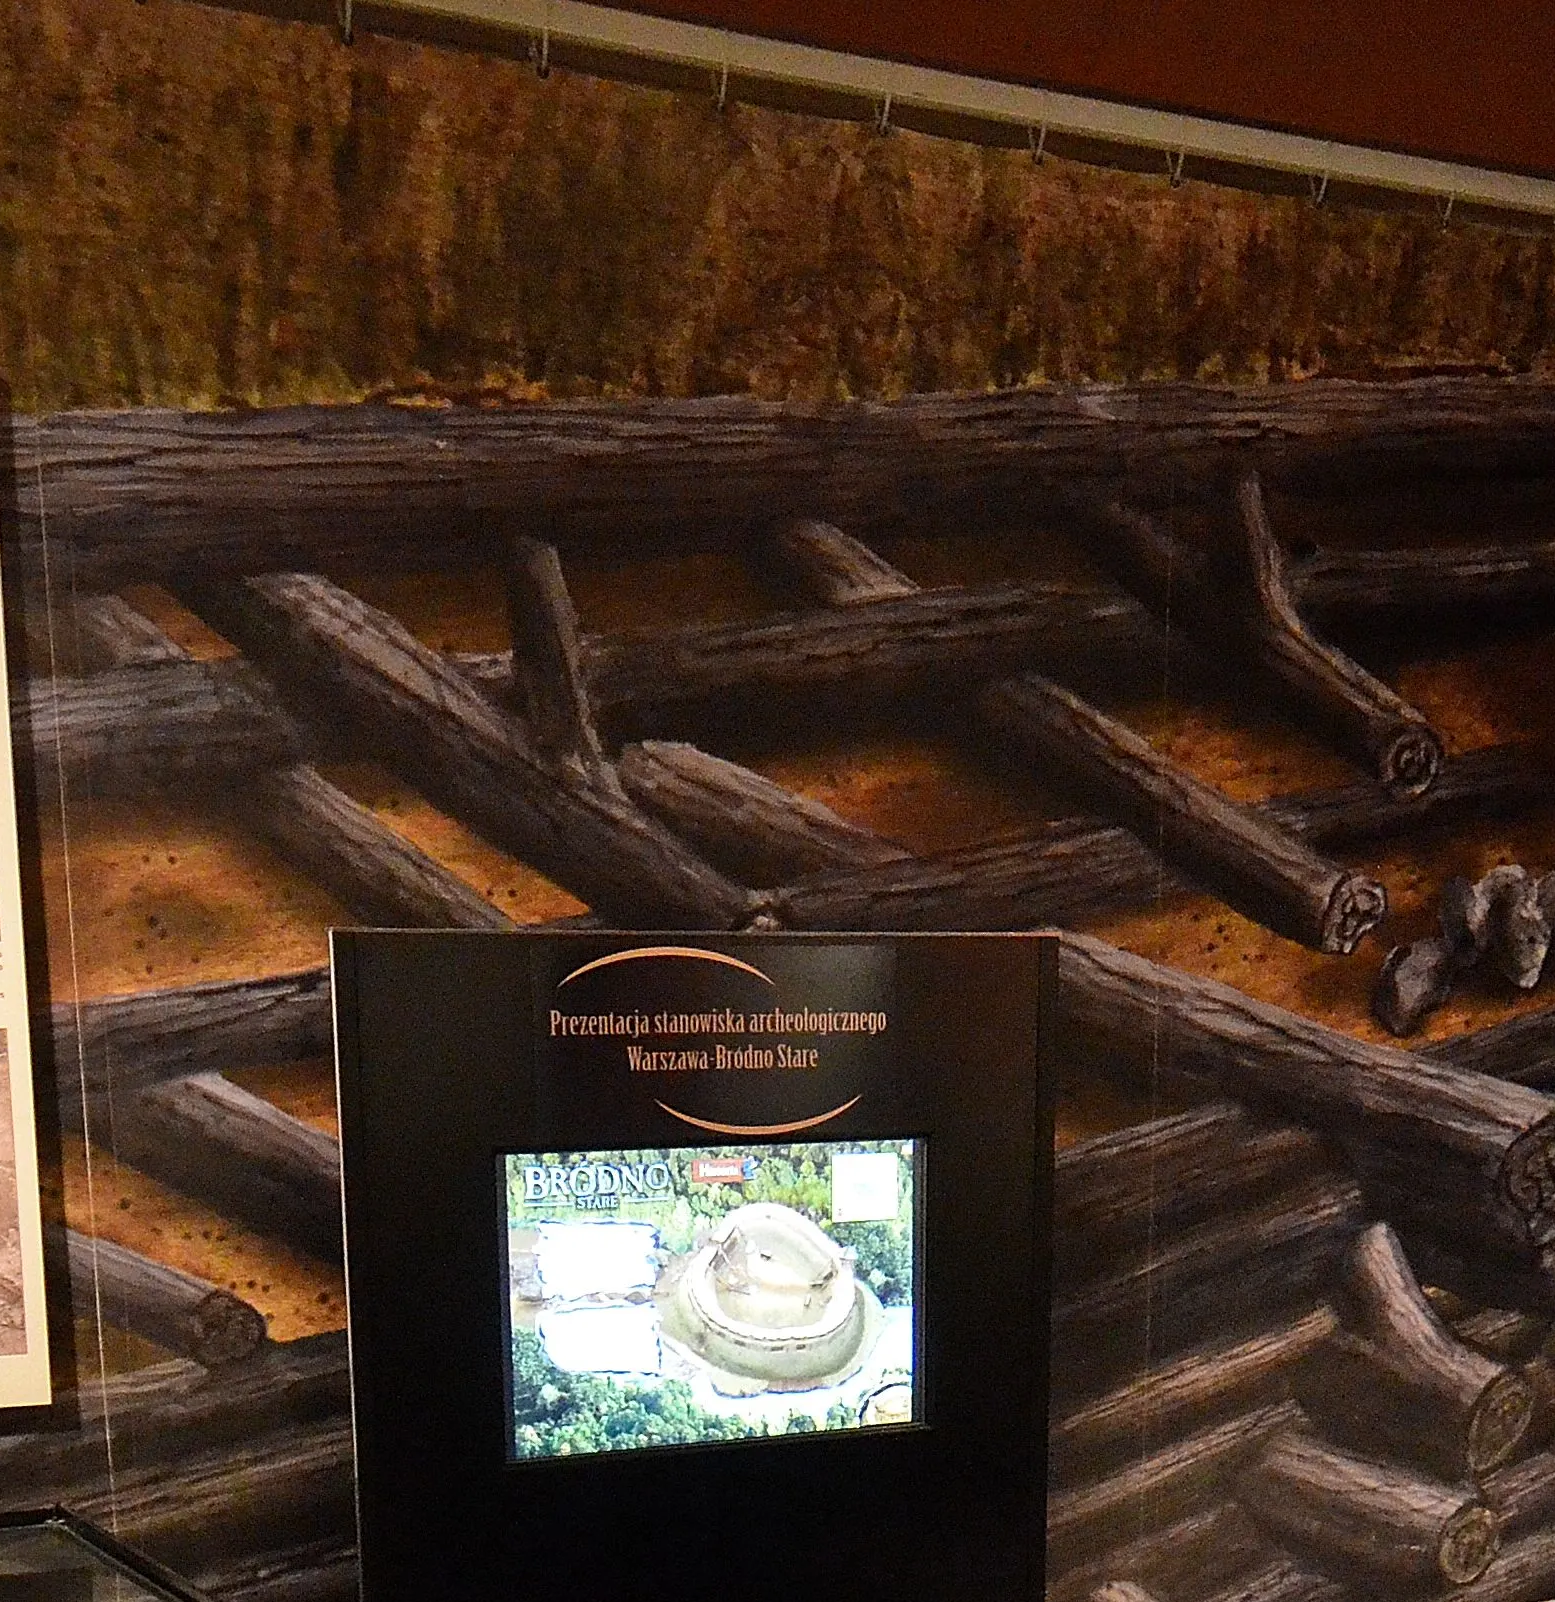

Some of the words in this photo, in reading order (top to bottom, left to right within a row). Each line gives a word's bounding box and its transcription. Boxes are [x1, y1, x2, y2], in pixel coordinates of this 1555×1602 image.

[549, 1009, 650, 1038] Prezentacja
[653, 1008, 745, 1035] stanowiska
[749, 1006, 887, 1035] archeologicznego
[627, 1043, 774, 1071] Warszawa-Bródno
[777, 1043, 819, 1069] Stare
[523, 1160, 670, 1199] BRÓDNO
[576, 1197, 619, 1209] STARE
